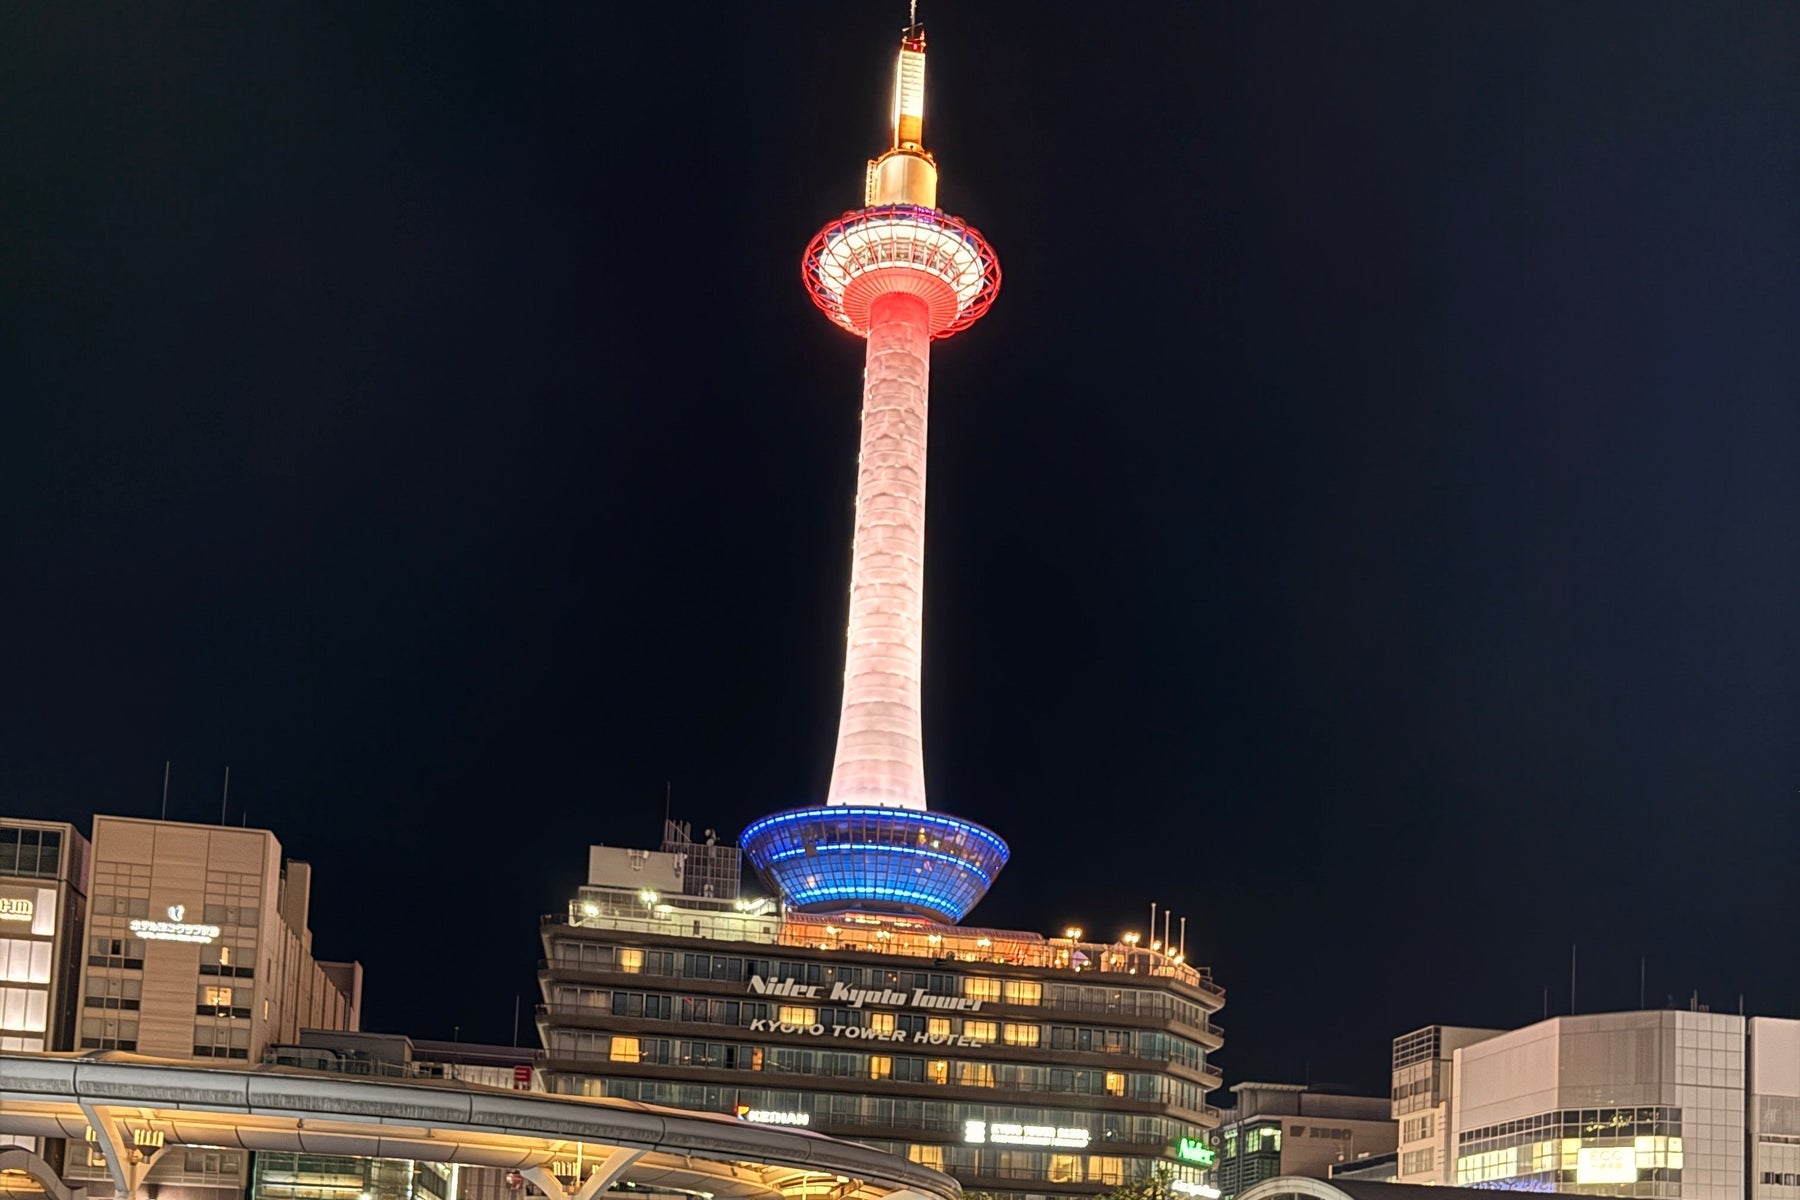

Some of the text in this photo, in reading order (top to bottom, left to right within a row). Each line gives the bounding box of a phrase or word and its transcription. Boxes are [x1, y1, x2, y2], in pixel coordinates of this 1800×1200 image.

[747, 975, 984, 1012] Nidec Kyoto Tower
[750, 1018, 984, 1048] KYOTO TOWER HOTEL
[1178, 1138, 1215, 1164] Nidec
[1590, 1150, 1624, 1161] ECC
